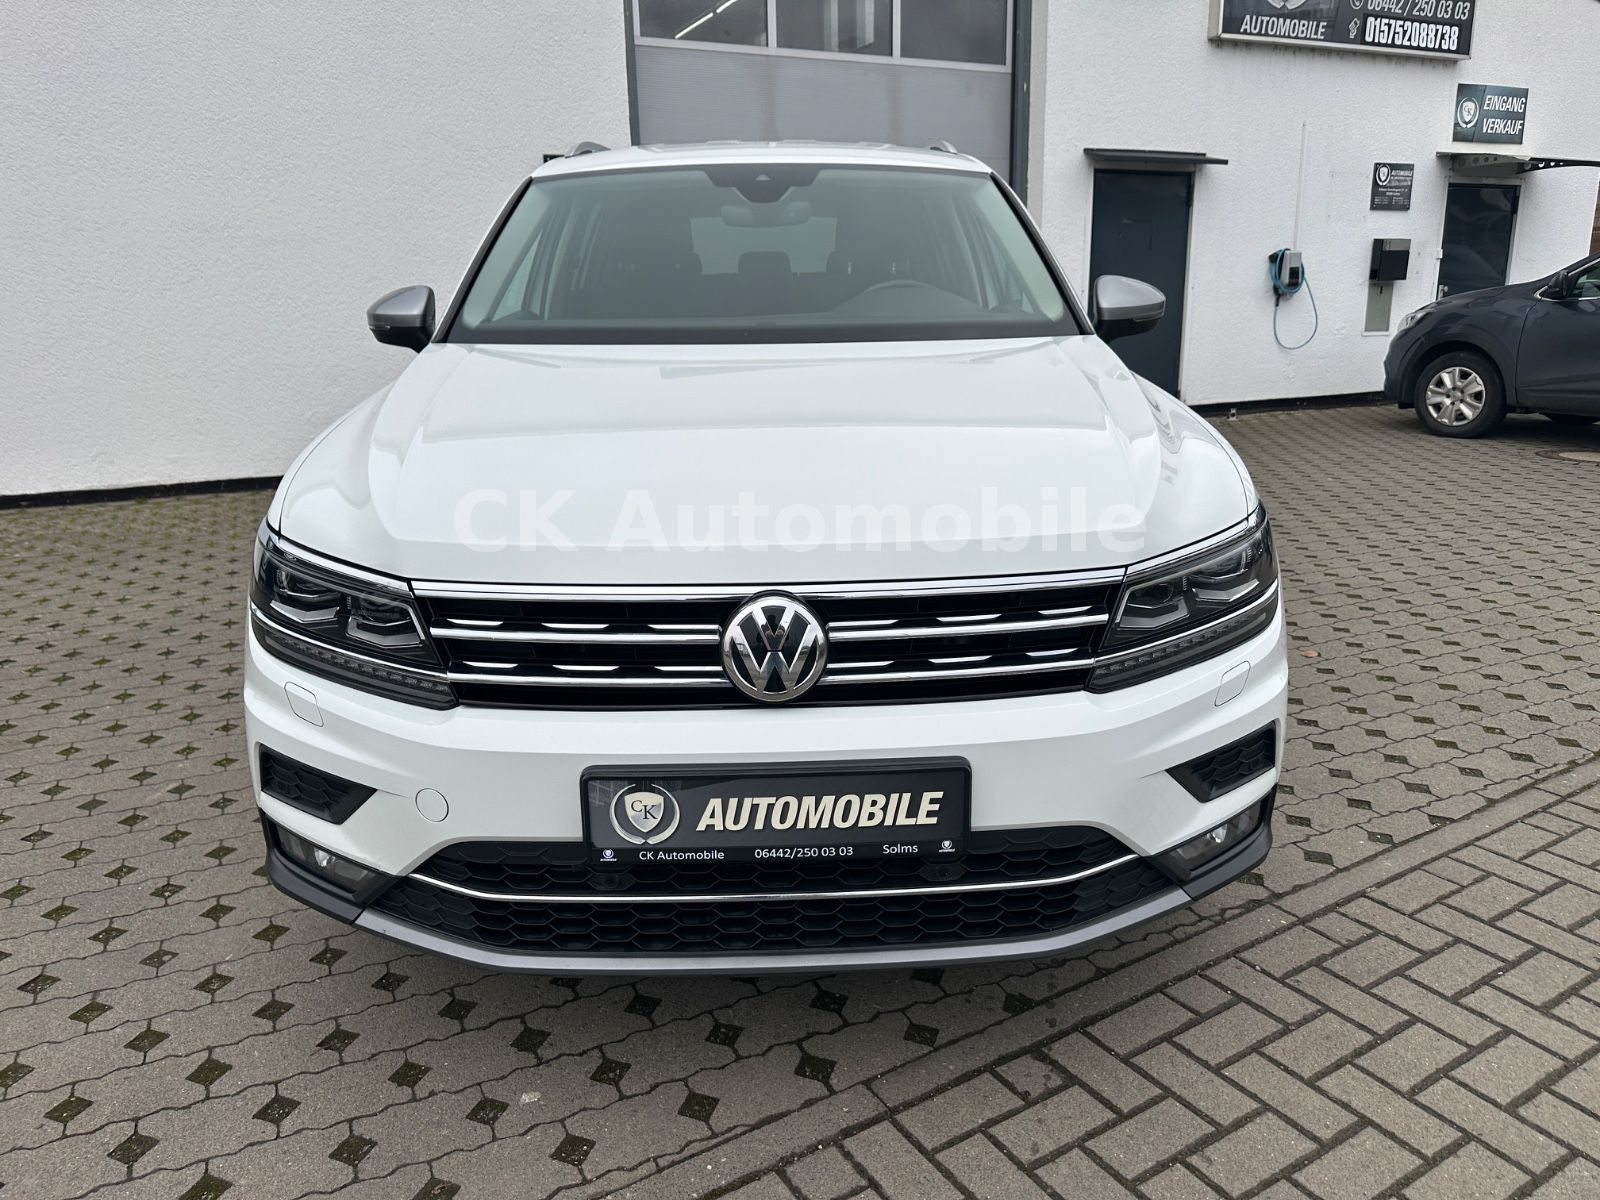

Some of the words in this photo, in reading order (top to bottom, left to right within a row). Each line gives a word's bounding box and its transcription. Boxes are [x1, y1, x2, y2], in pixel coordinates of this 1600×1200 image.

[1412, 0, 1435, 17] 250
[1437, 0, 1453, 18] 03
[1454, 2, 1470, 20] 03
[1240, 14, 1328, 40] AUTOMOBILE
[1364, 16, 1459, 50] 015752088738
[1483, 95, 1526, 112] EINGANG
[1482, 118, 1524, 135] VERKAUF
[630, 799, 658, 820] CK
[696, 791, 944, 832] AUTOMOBILE
[638, 850, 655, 860] CK
[656, 850, 725, 860] Automobile
[754, 847, 819, 859] 06442/250
[821, 846, 836, 857] 03
[838, 846, 854, 856] 03
[882, 843, 919, 854] Solms
